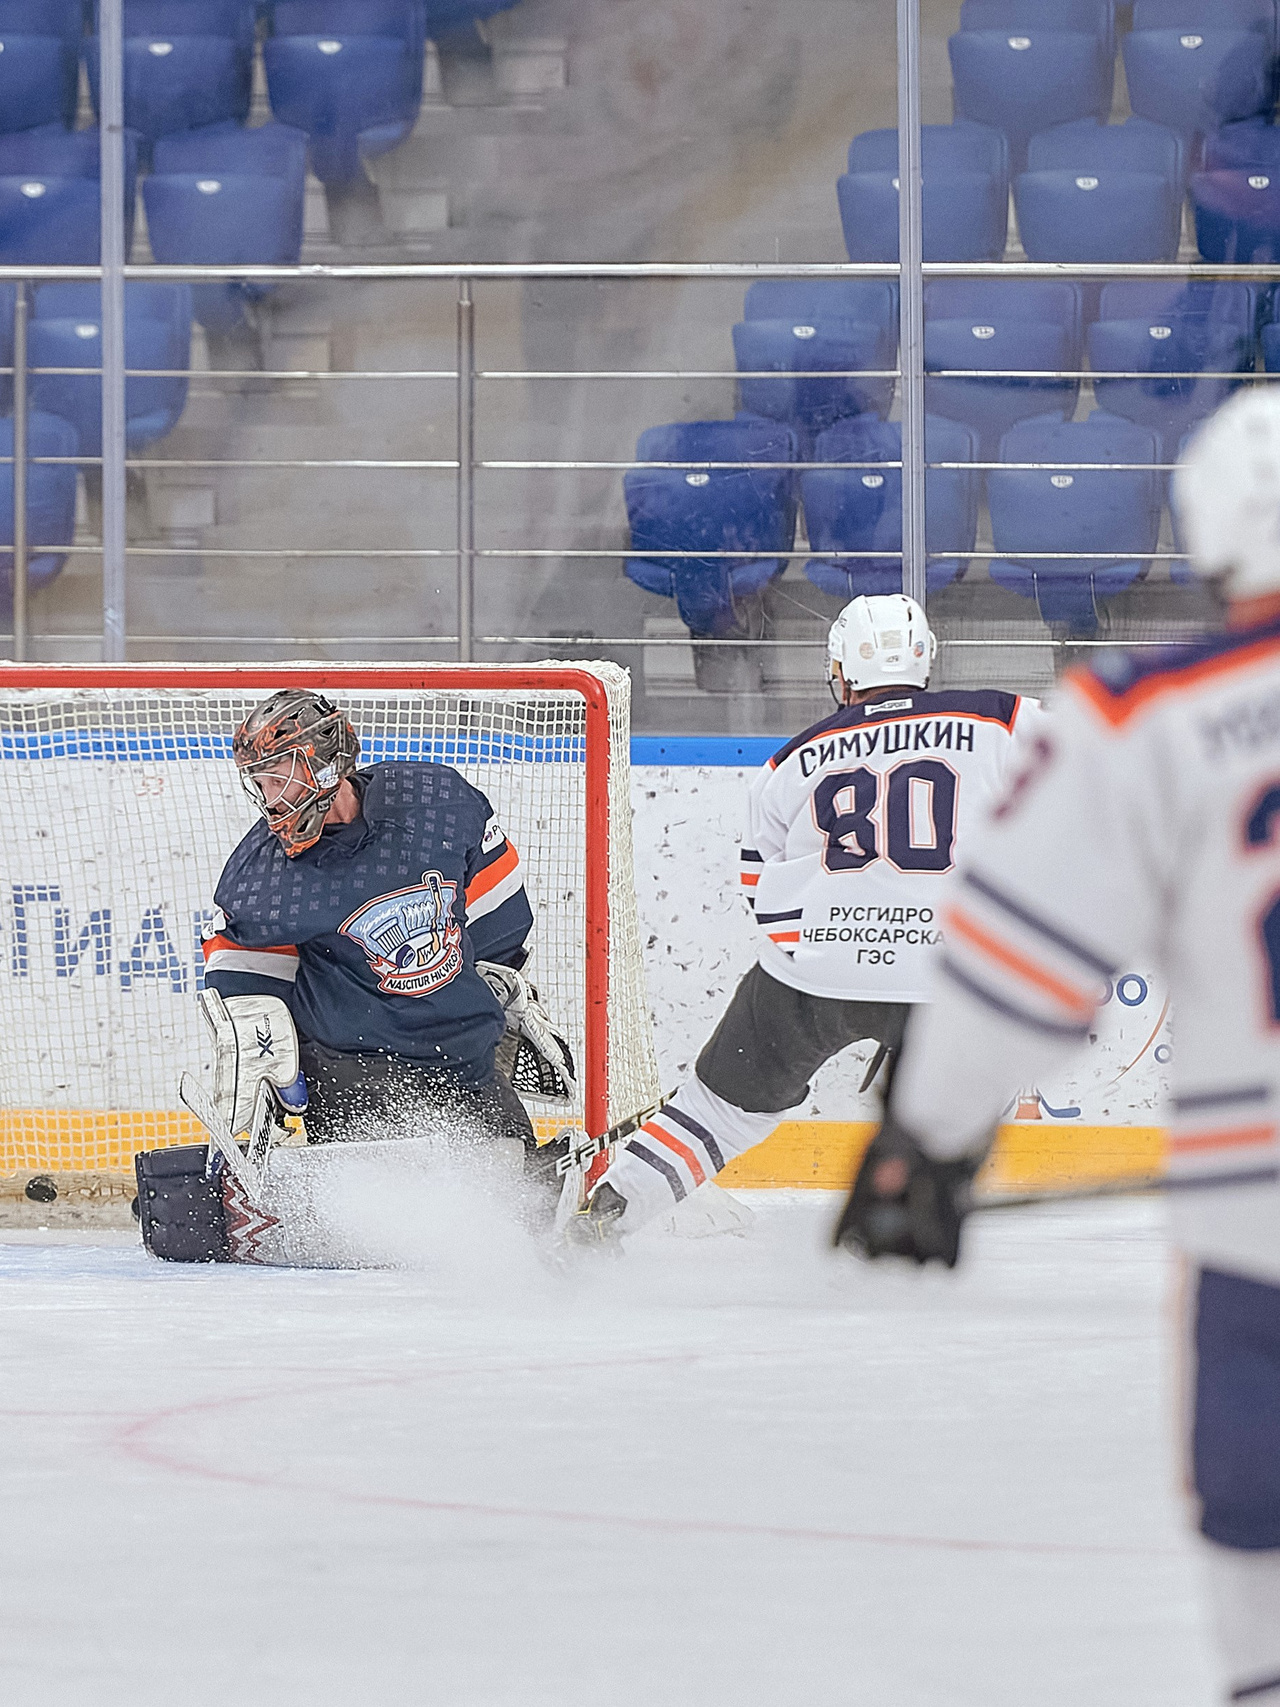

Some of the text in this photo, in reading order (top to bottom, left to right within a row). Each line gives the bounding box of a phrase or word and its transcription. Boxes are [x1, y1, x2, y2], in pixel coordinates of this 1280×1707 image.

[799, 720, 975, 778] СИМУШКИН
[811, 755, 960, 875] 80
[830, 907, 934, 925] РУСГИДРО
[803, 928, 946, 945] ЧЕБОКСАРСКА
[857, 949, 896, 965] ГЭС
